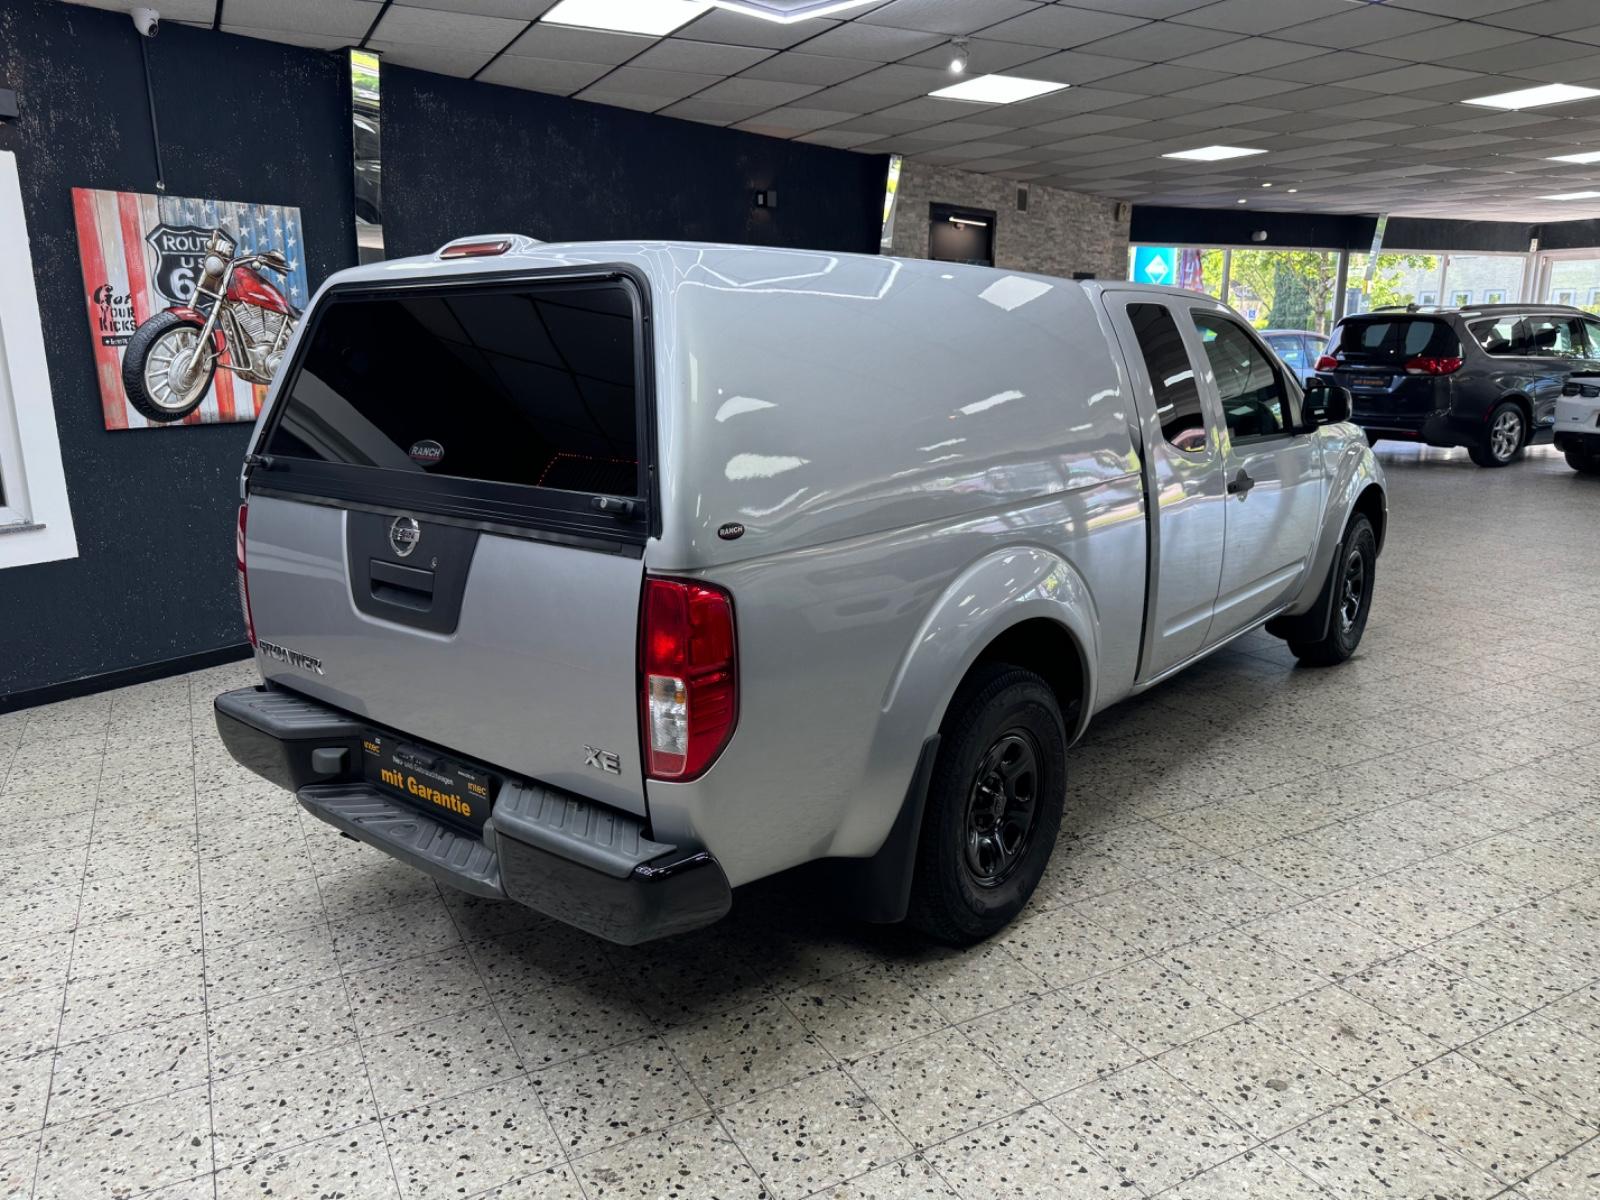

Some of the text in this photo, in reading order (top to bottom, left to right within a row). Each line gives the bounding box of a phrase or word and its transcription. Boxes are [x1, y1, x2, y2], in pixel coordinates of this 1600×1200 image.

[163, 235, 209, 251] ROUT
[99, 317, 138, 332] KICKS
[411, 446, 441, 457] RANCH
[720, 526, 743, 536] RANCH
[583, 745, 621, 775] XE
[381, 768, 472, 817] mit Garantie
